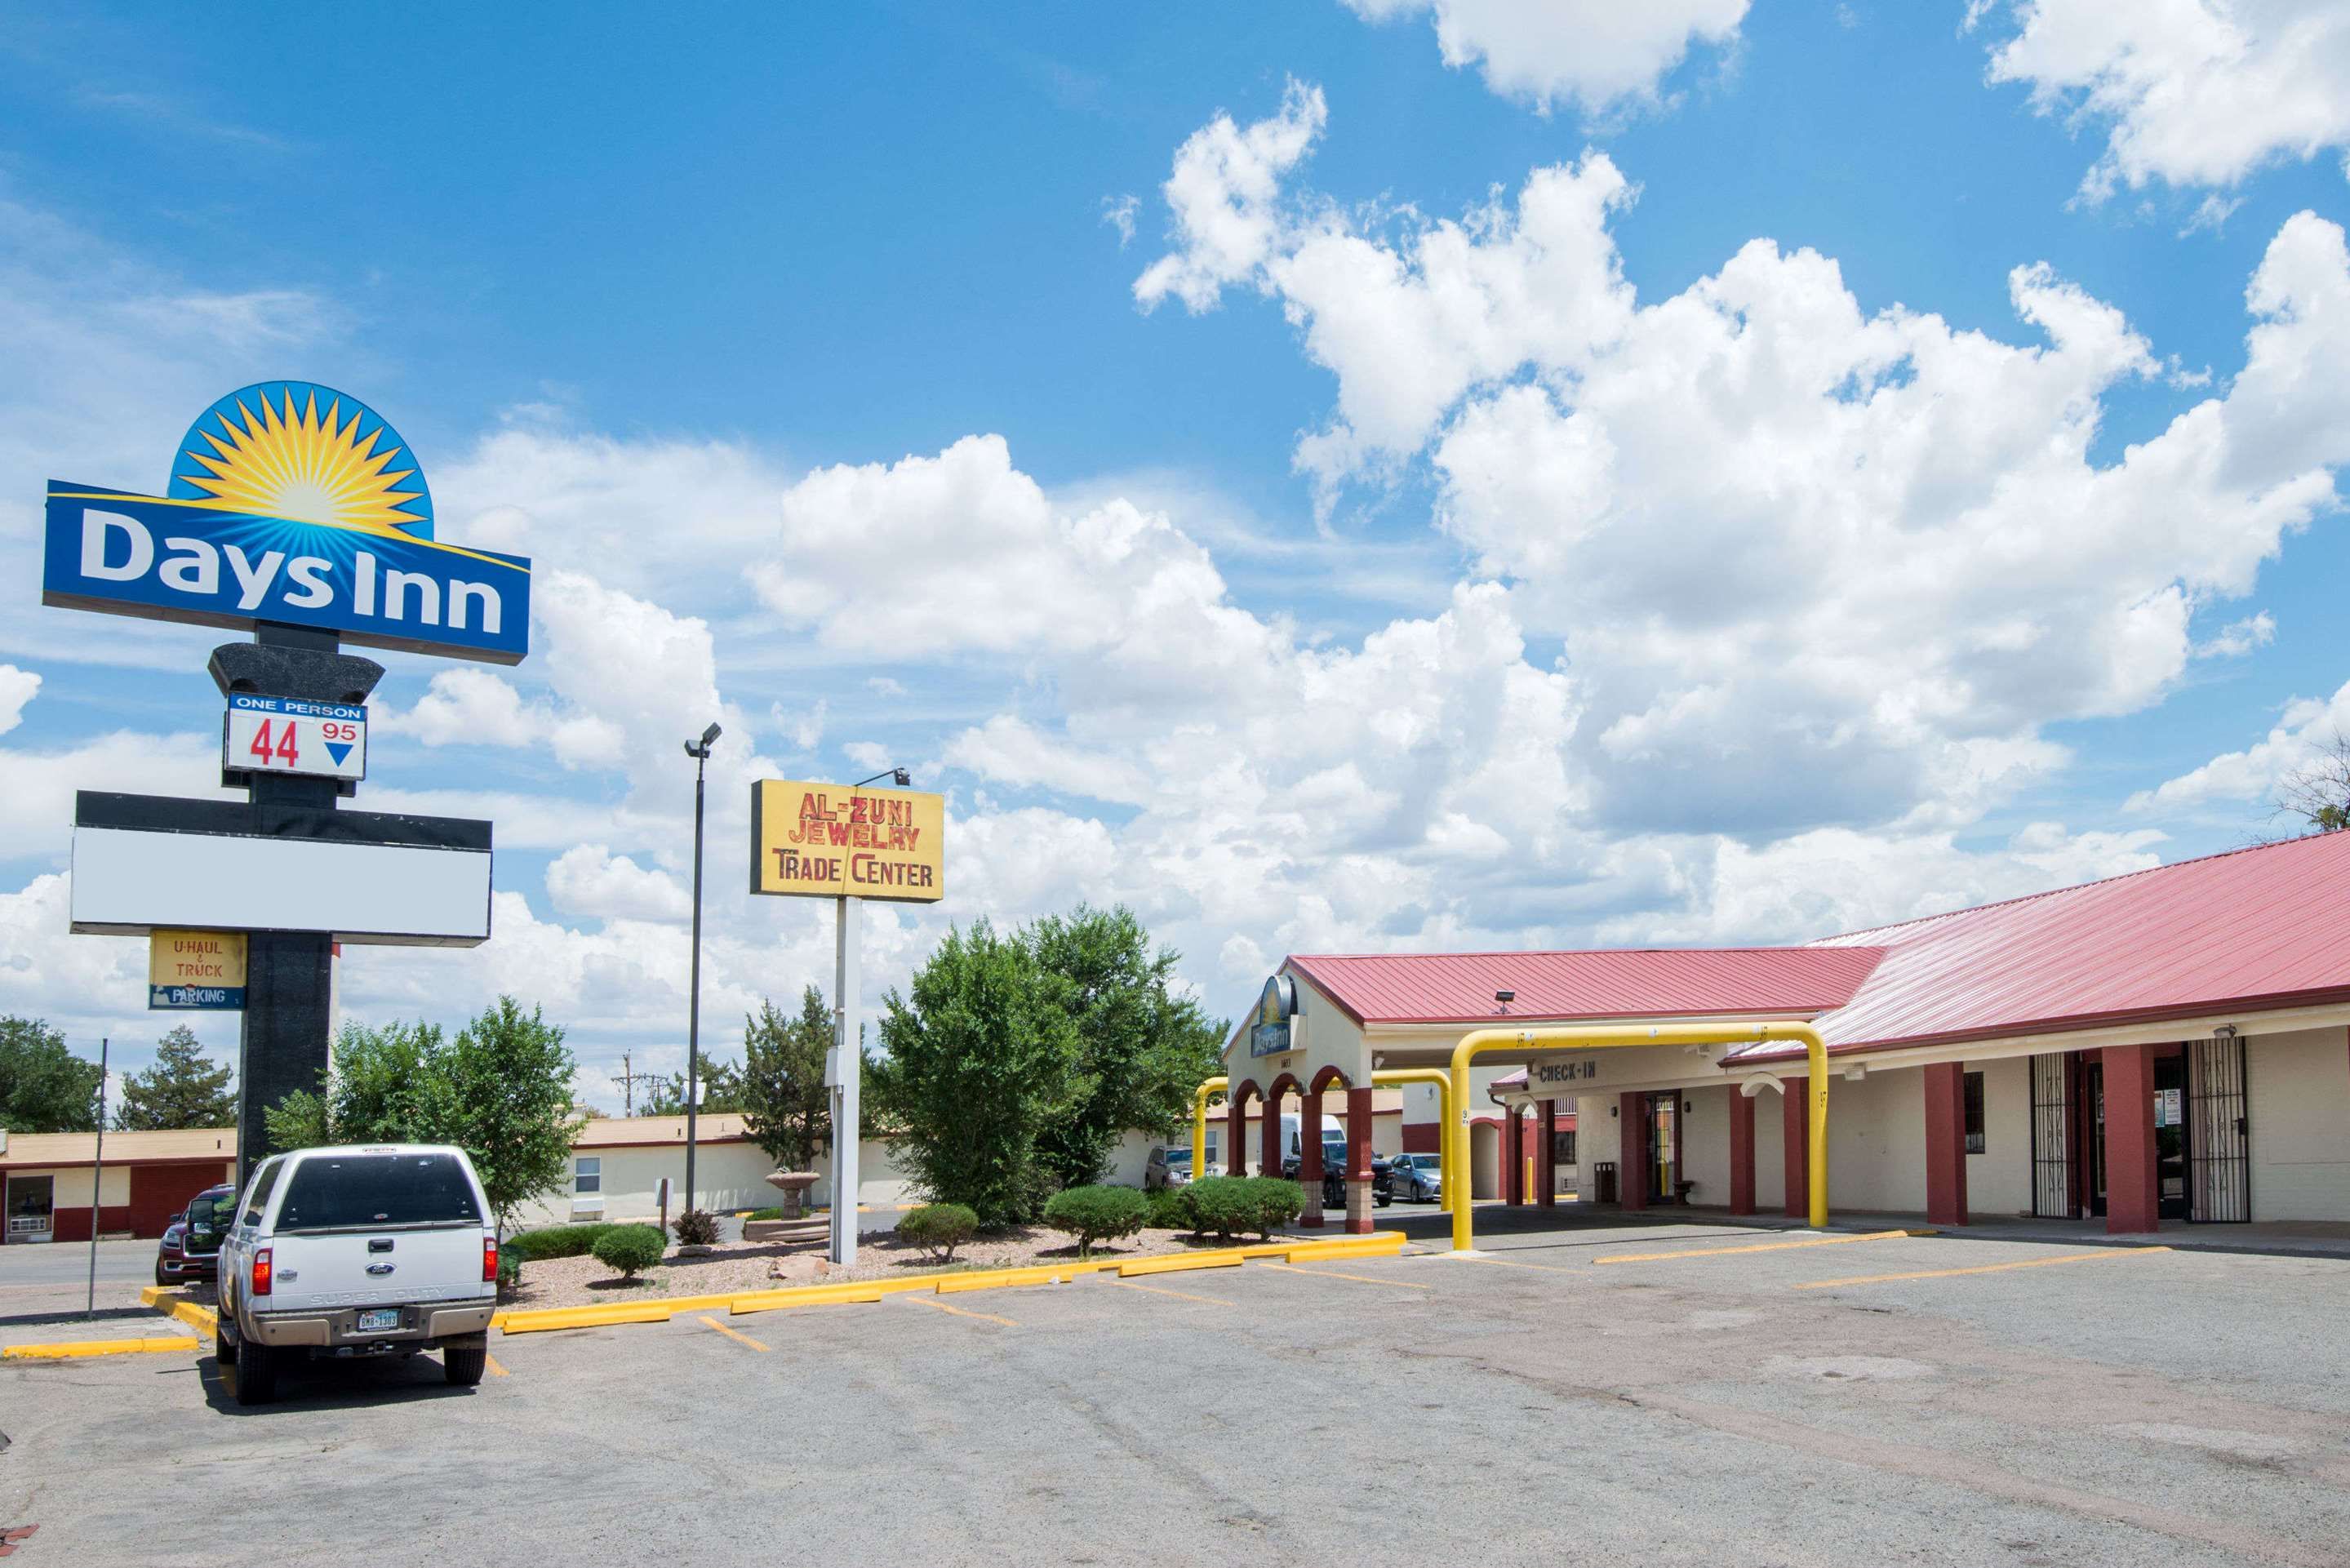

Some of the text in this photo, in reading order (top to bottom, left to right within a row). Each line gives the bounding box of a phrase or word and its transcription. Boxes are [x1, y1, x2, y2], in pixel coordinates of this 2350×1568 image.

[81, 508, 502, 633] Days Inn
[237, 697, 361, 719] ONE PERSON
[250, 717, 299, 767] 44
[322, 722, 357, 741] 95
[798, 793, 913, 827] AL-ZUNI
[788, 820, 921, 851] JEWELRY
[772, 847, 933, 887] TRADE CENTER
[176, 963, 223, 978] TRUCK
[172, 988, 225, 1003] PARKING
[372, 1265, 389, 1273] Ford
[309, 1286, 447, 1305] SUPER DUTY
